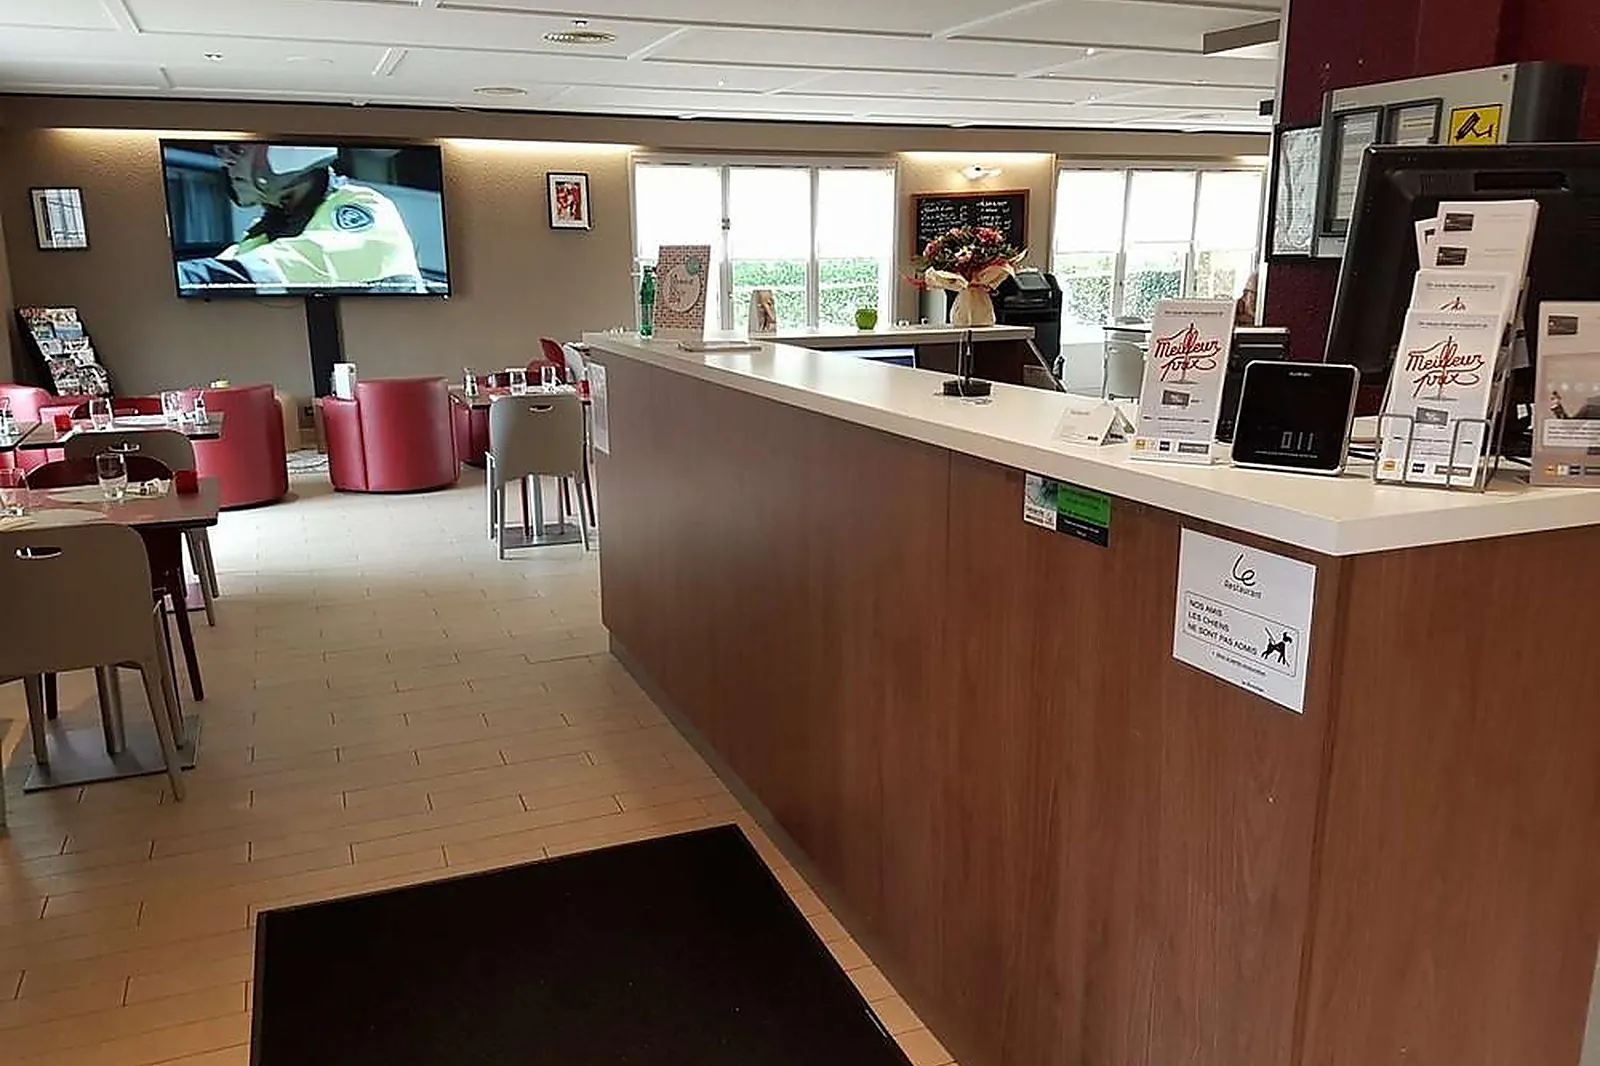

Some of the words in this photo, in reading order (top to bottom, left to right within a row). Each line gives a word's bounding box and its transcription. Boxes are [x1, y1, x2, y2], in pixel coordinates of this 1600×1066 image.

[1155, 330, 1220, 359] Meilleur
[1406, 342, 1484, 372] Meilleur
[1232, 553, 1256, 587] Le
[1189, 599, 1204, 611] NOS
[1188, 611, 1201, 621] LES
[1203, 615, 1230, 633] CHIENS
[1199, 627, 1218, 639] SONT
[1219, 634, 1233, 646] PAS
[1233, 641, 1258, 655] ADMIS
